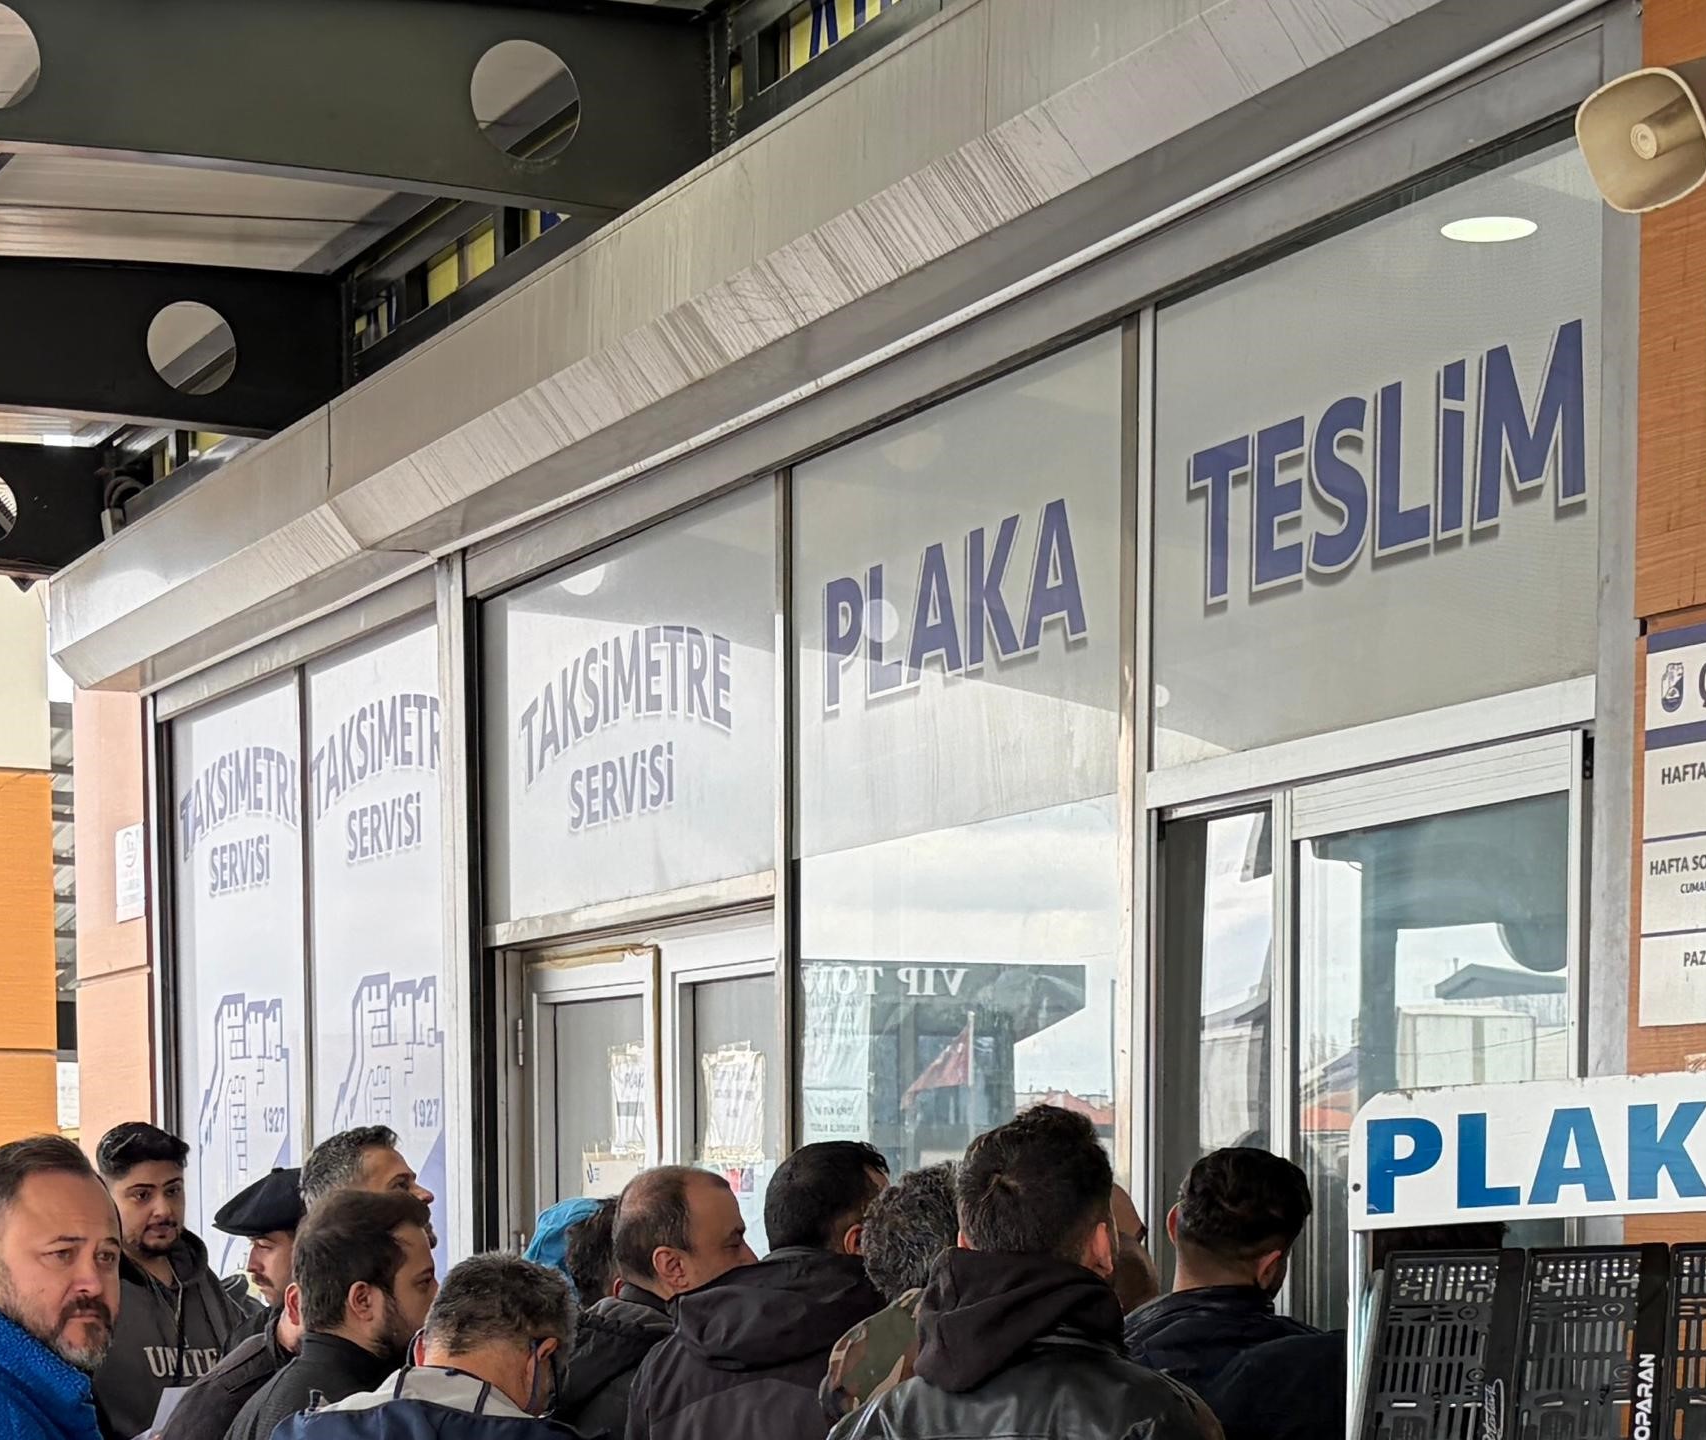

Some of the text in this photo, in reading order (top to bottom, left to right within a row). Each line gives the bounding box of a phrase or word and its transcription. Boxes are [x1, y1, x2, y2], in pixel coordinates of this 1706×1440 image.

[822, 498, 1088, 713] PLAKA
[1661, 762, 1706, 786] HAFTA
[1650, 857, 1689, 876] HAFTA
[263, 1106, 285, 1132] 1927
[412, 1097, 439, 1128] 1927
